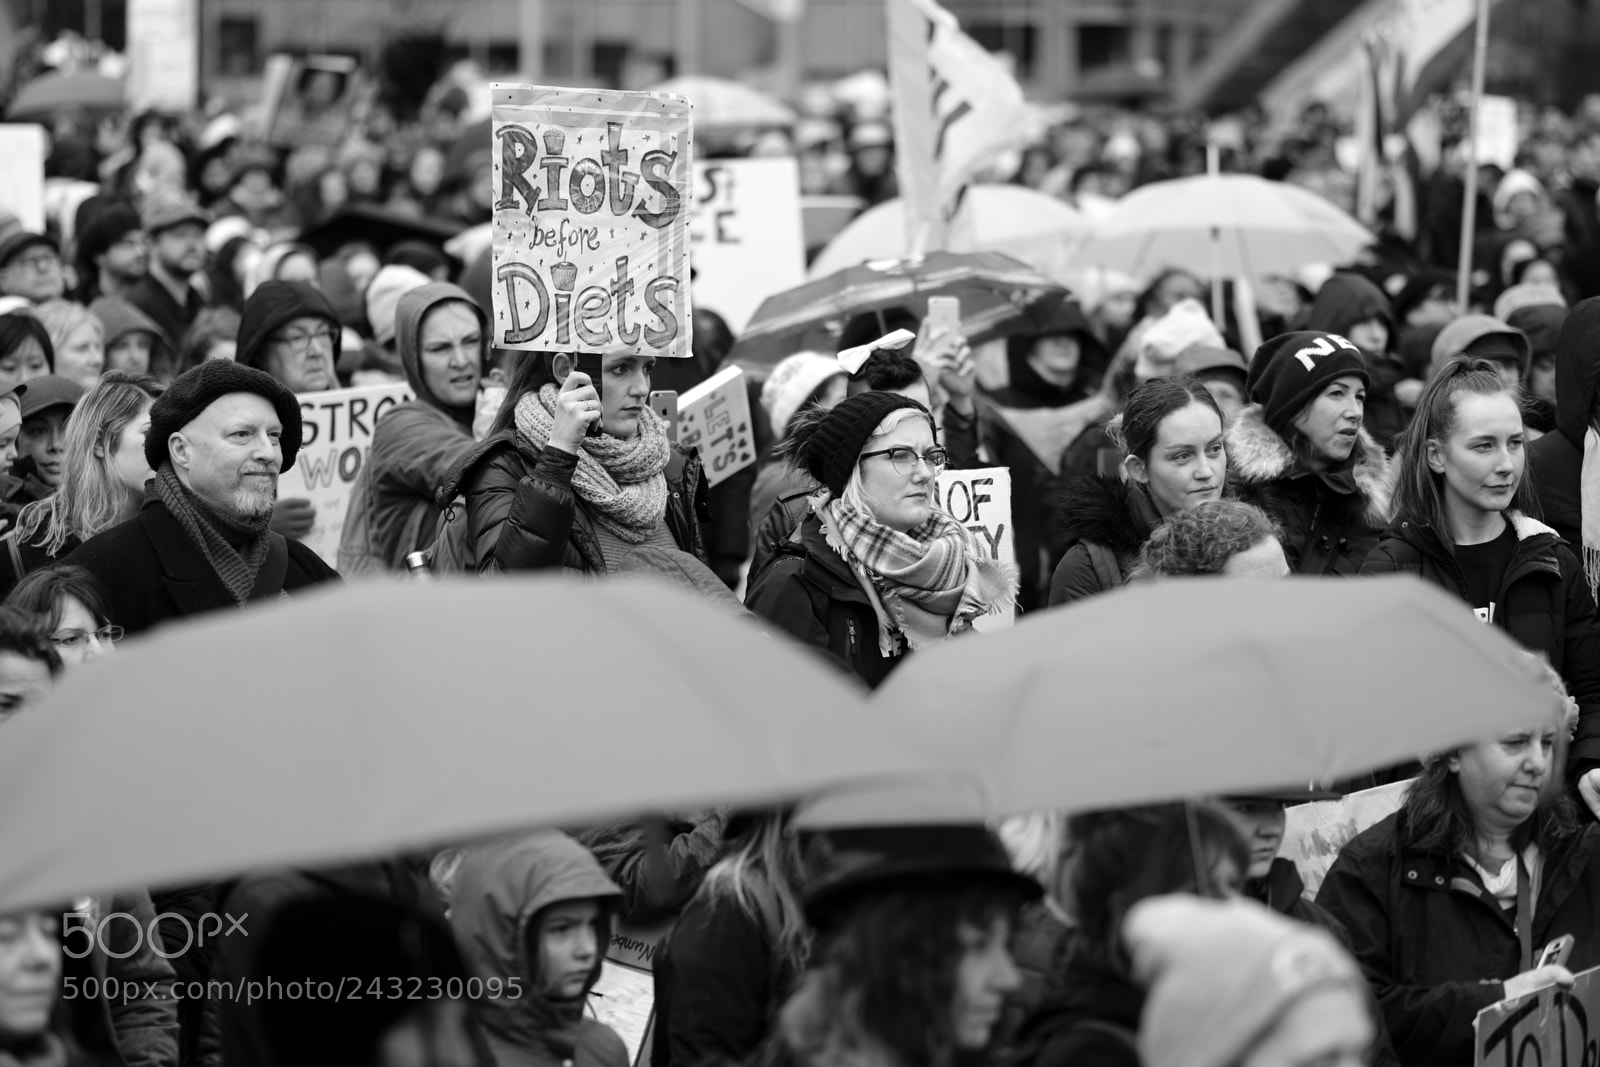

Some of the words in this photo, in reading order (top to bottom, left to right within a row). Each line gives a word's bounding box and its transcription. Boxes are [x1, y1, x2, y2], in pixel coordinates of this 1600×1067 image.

[495, 121, 681, 229] Riots
[529, 216, 600, 257] before
[496, 255, 679, 348] Diets
[300, 393, 410, 446] STRO
[298, 446, 373, 491] WO
[946, 477, 993, 524] OF
[610, 933, 657, 962] Numbe
